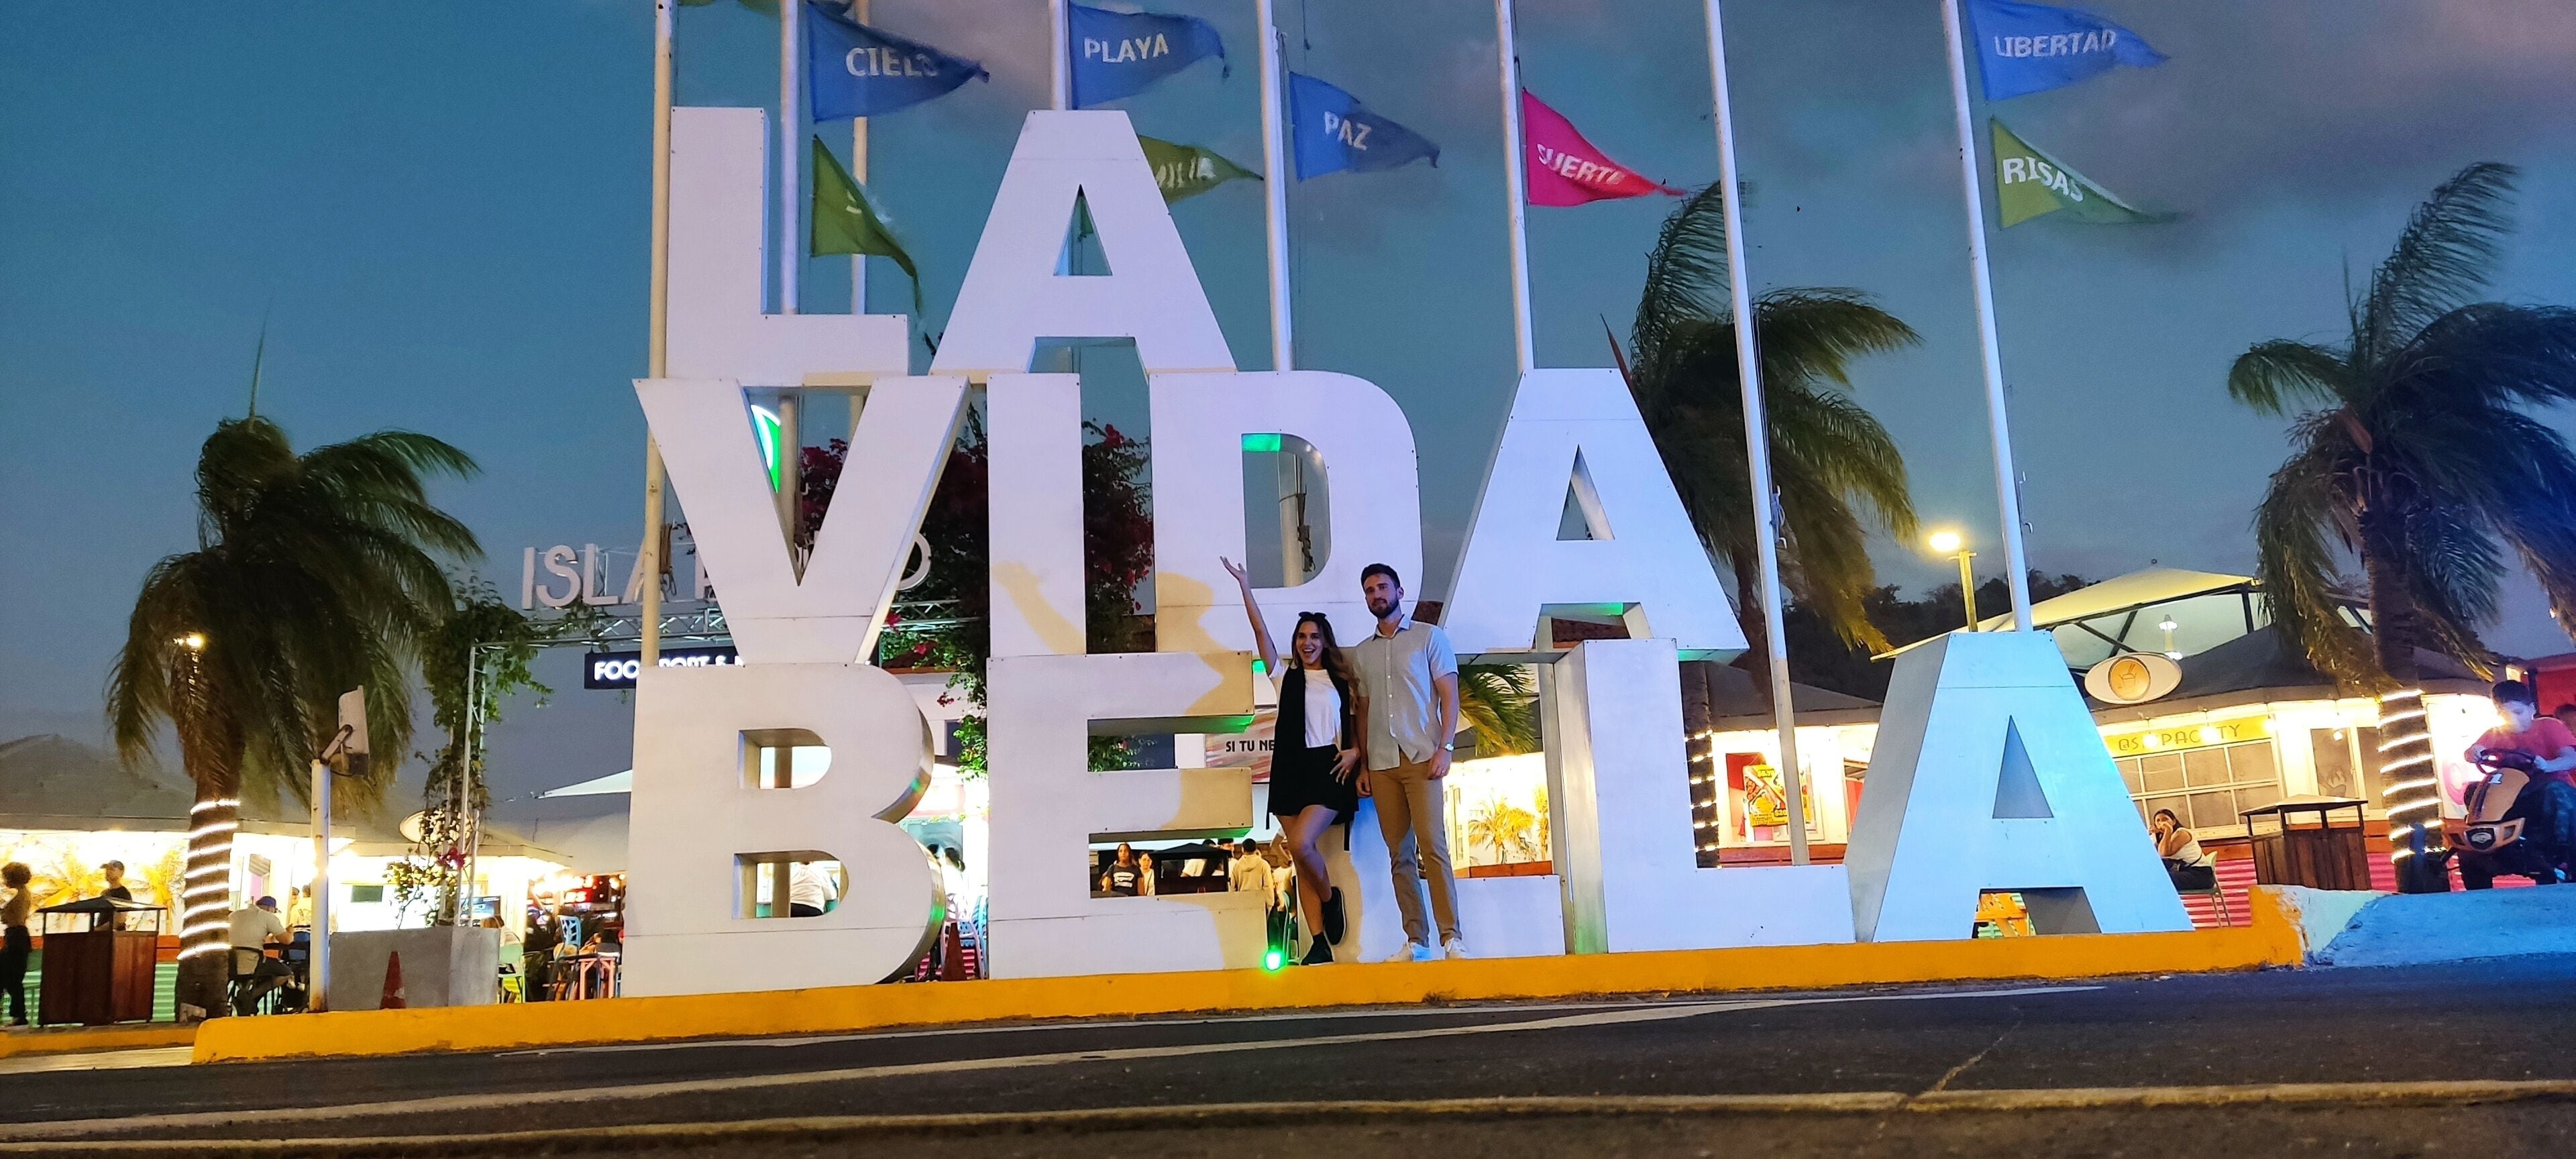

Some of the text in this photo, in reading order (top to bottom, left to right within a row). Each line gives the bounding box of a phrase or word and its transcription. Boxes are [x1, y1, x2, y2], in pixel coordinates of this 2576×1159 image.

[1083, 32, 1169, 63] PLAYA
[1994, 29, 2116, 58] LIBERTAD
[1324, 110, 1373, 151] PAZ
[2002, 156, 2084, 203] RISAS
[664, 109, 1236, 380] LA
[633, 369, 1748, 661] VIDA
[594, 659, 641, 681] FOO
[1225, 739, 1275, 753] SI TU NE
[2118, 723, 2241, 751] @SPACTY
